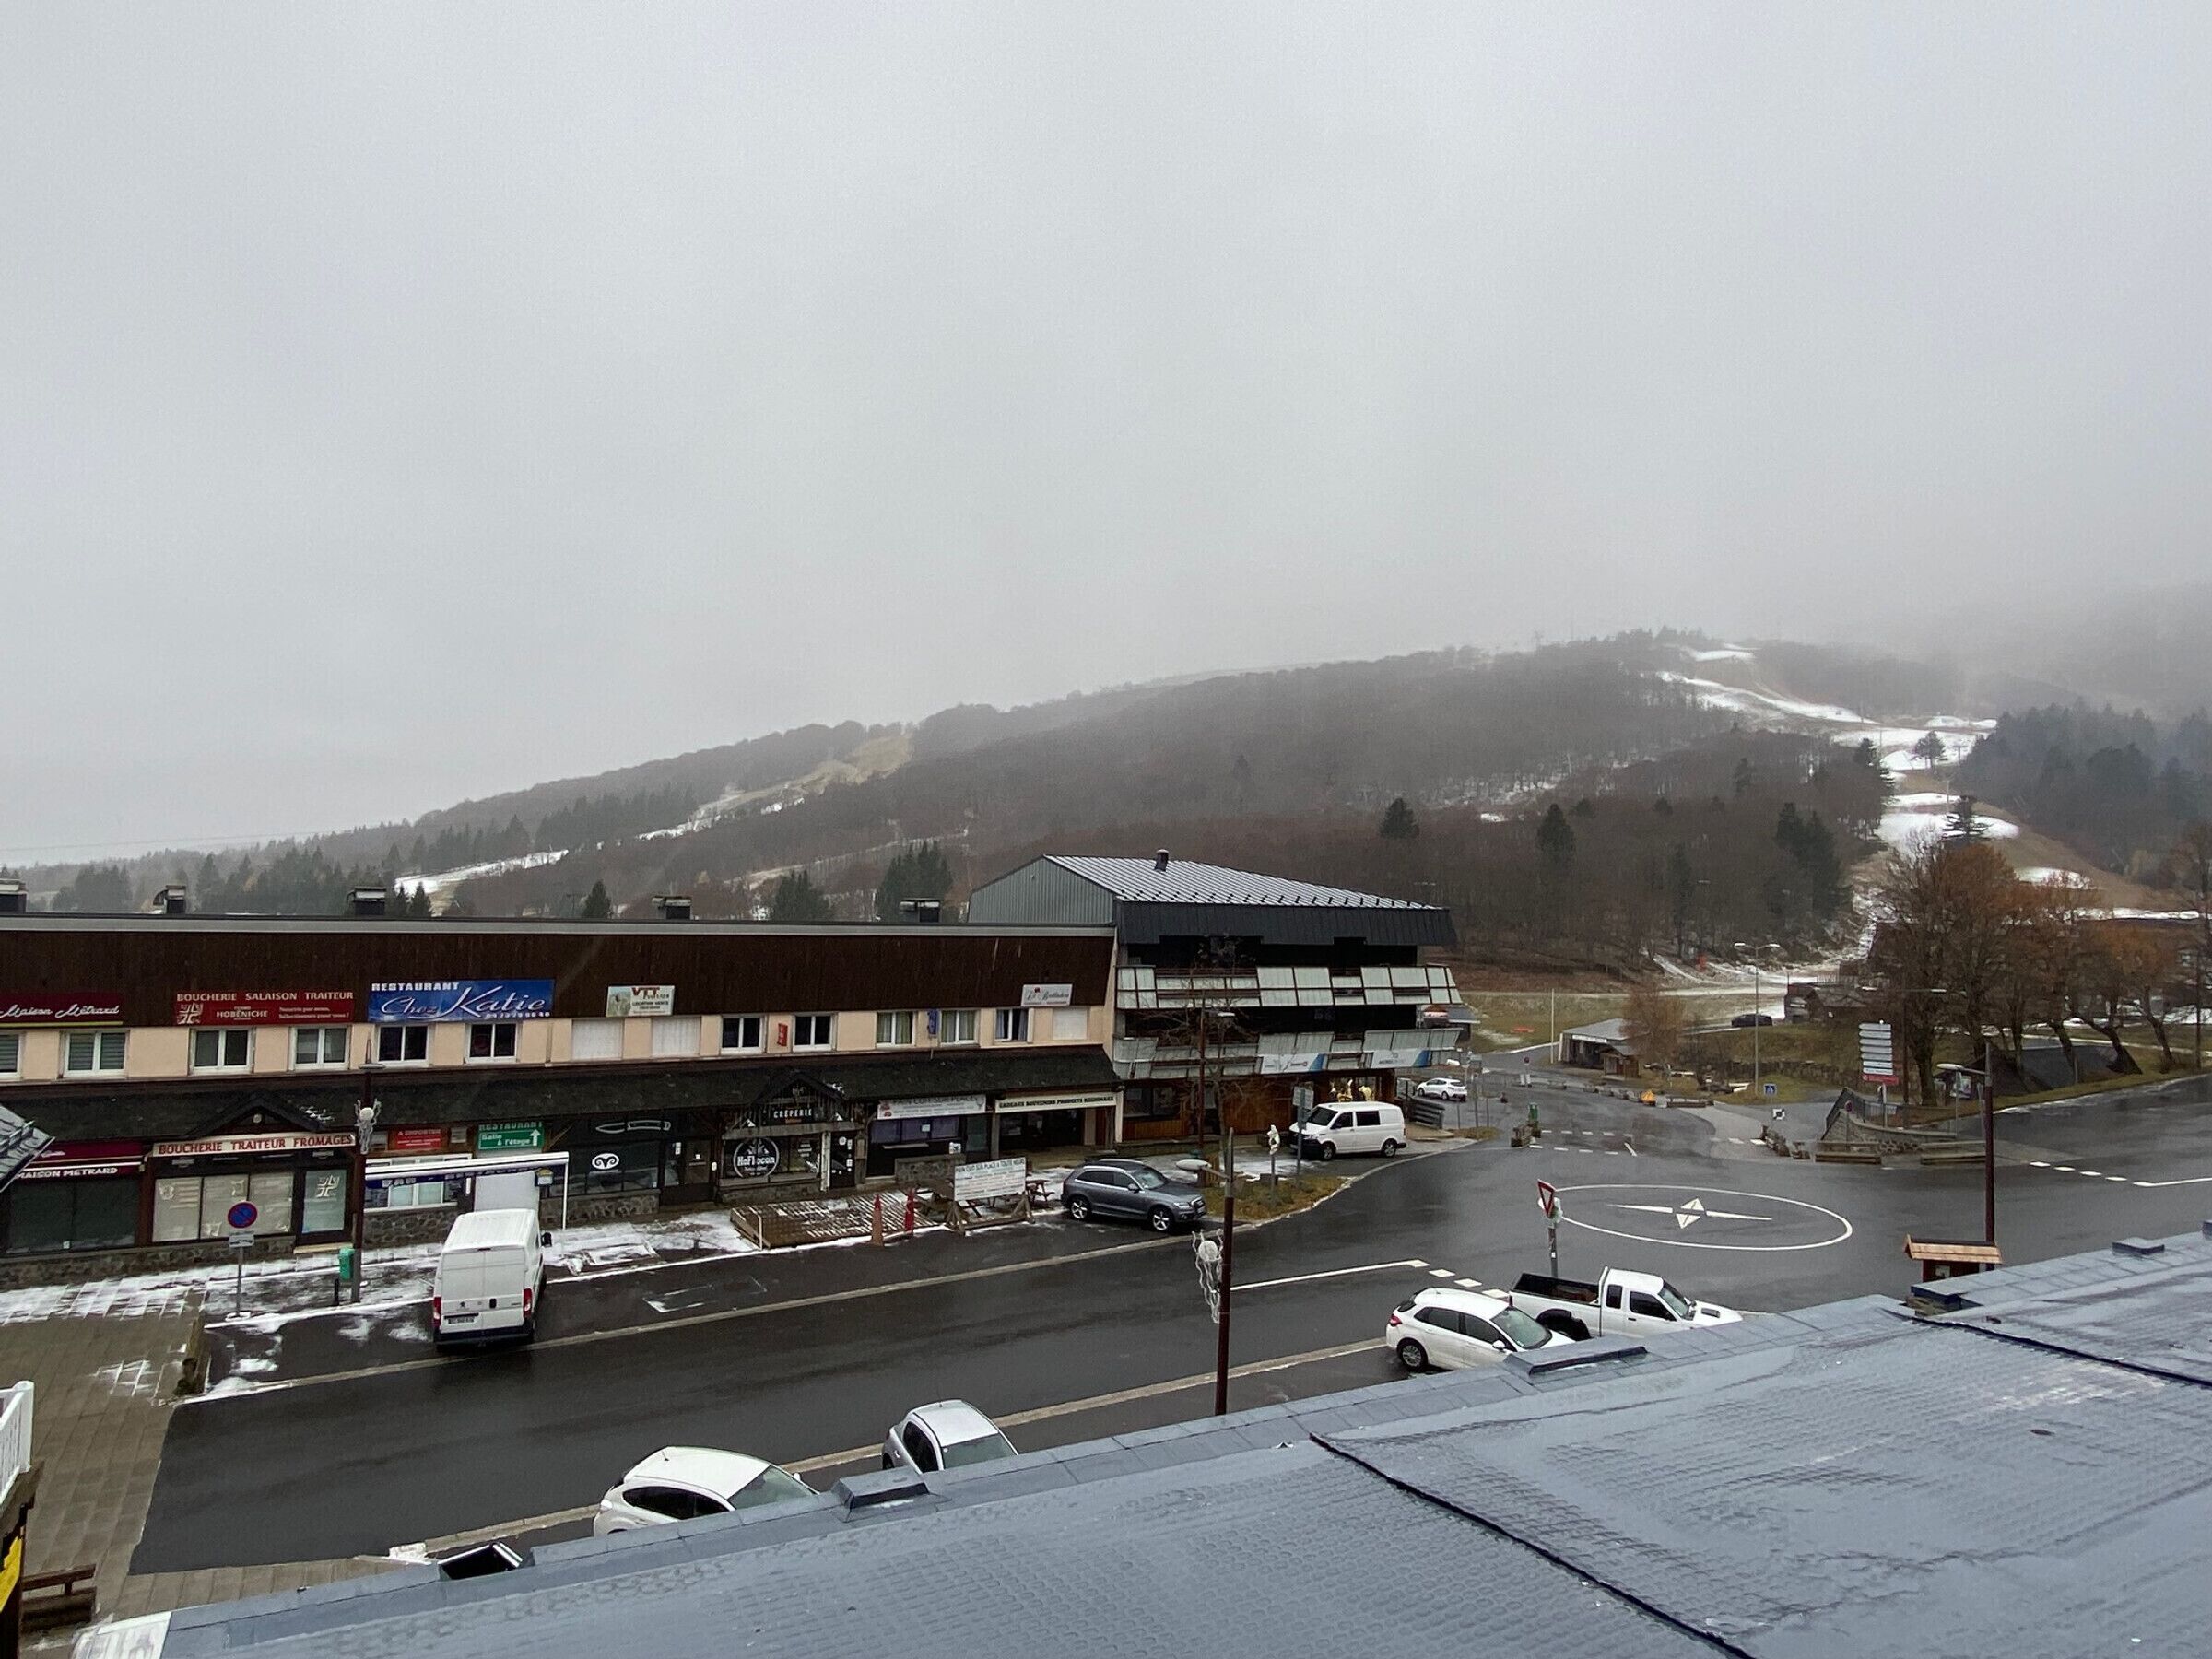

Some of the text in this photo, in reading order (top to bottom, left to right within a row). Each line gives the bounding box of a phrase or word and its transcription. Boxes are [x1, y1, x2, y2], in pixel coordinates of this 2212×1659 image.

[371, 982, 460, 991] RESTAURANT
[632, 987, 660, 996] VTT
[177, 992, 354, 1002] BOUCHERIE SALAISON TRAITEUR
[408, 985, 546, 1020] Katie
[0, 1003, 120, 1018] Maison Métrard
[478, 1122, 543, 1131] RESTAURANT
[159, 1135, 352, 1155] BOUCHERIE TRAITEUR FROMAGES
[18, 1170, 61, 1180] MAISON
